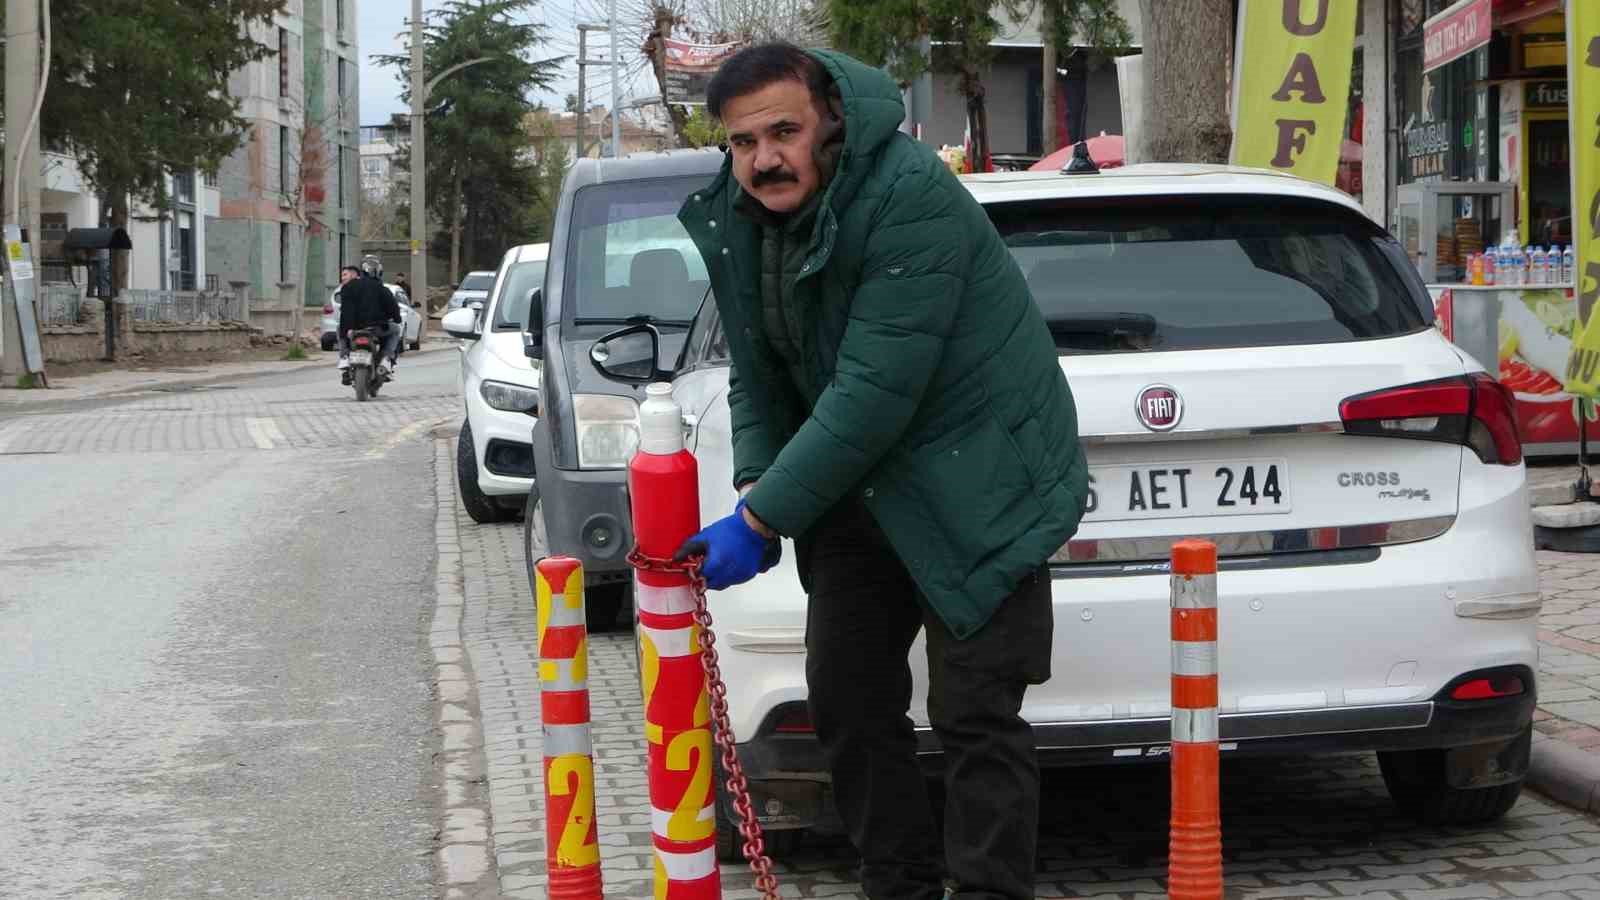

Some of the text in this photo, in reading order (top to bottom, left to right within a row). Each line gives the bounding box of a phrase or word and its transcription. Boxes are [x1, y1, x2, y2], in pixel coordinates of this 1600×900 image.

[1147, 398, 1173, 418] FIAT
[1128, 468, 1191, 511] AET
[1214, 464, 1282, 507] 244
[1337, 471, 1400, 487] CROSS
[549, 754, 599, 868] 2
